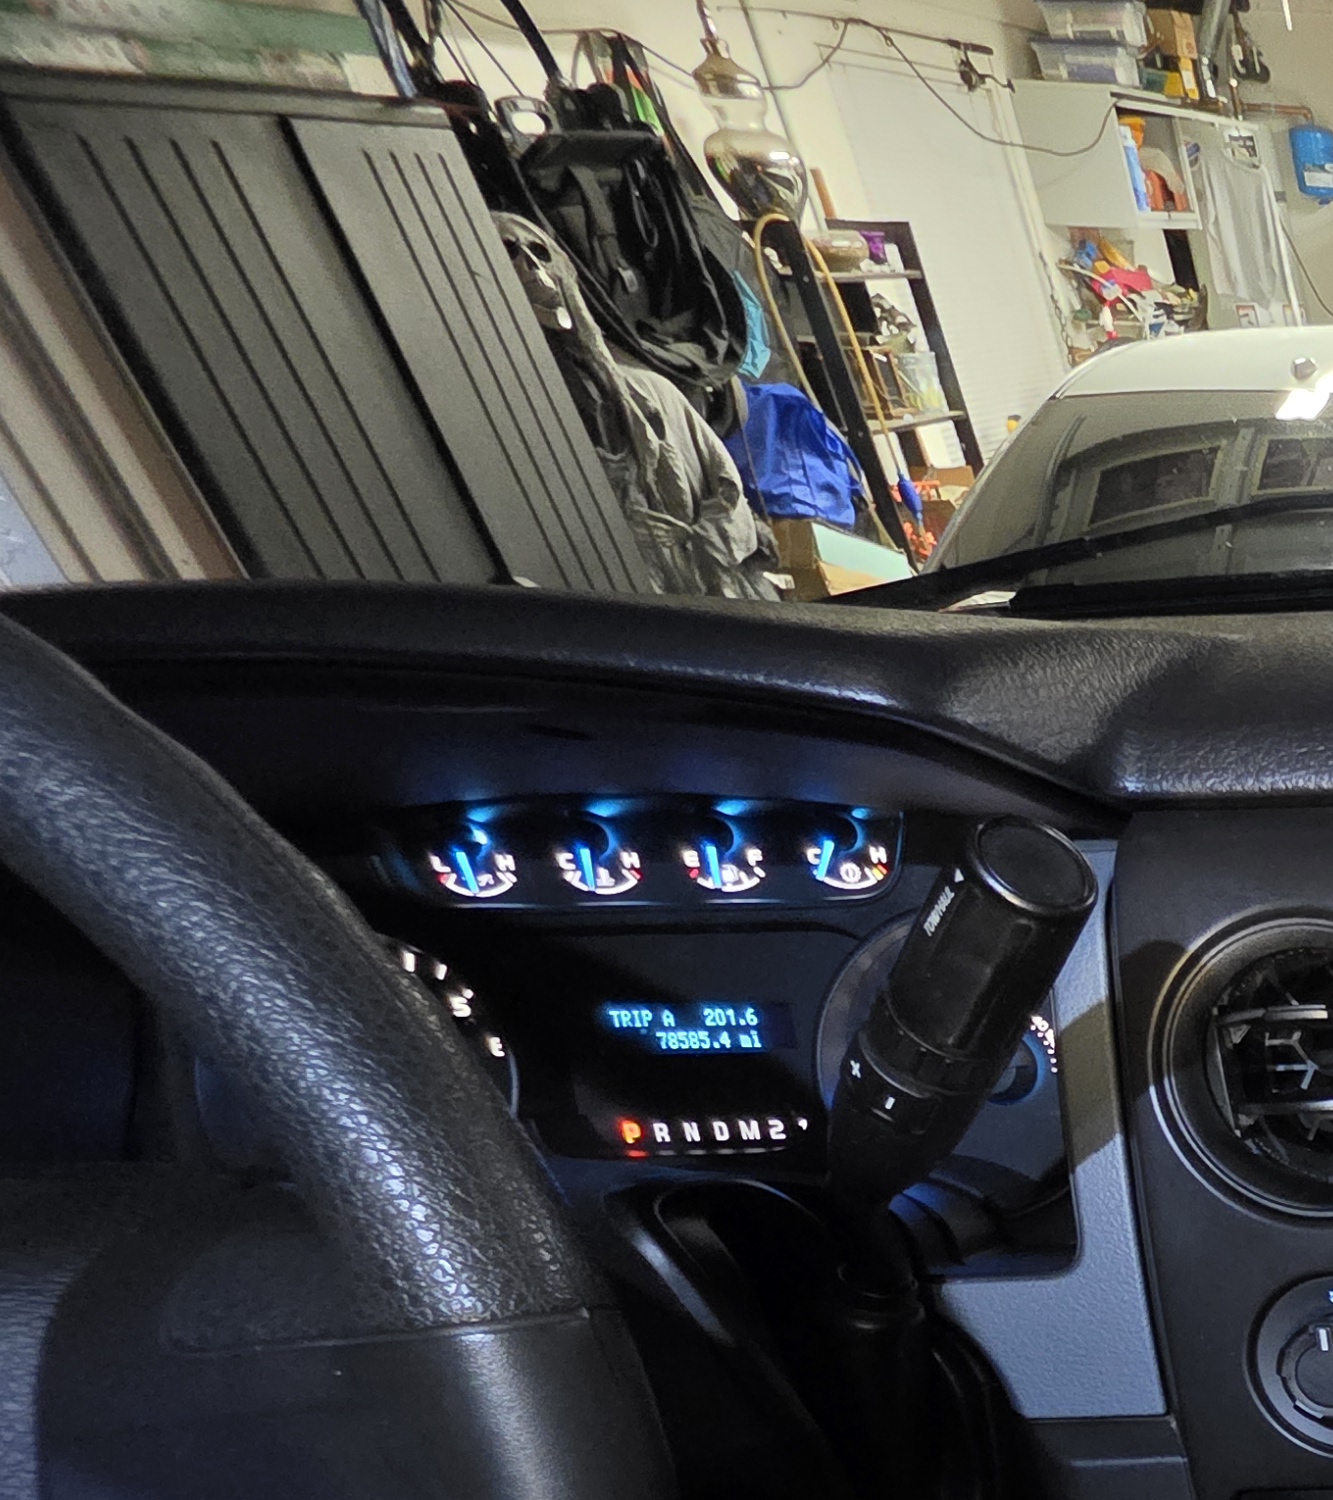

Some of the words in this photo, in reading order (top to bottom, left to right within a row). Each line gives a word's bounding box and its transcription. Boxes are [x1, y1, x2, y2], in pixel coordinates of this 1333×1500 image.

[619, 851, 641, 869] H
[682, 849, 700, 868] E
[748, 848, 764, 867] F
[870, 846, 888, 864] H
[608, 1008, 652, 1028] TRIP
[661, 1009, 676, 1028] A
[703, 1007, 758, 1027] 201.6
[656, 1030, 731, 1050] 78585.4
[739, 1029, 763, 1048] mi
[621, 1119, 642, 1145] P
[652, 1121, 671, 1143] R
[682, 1121, 701, 1142] N
[711, 1120, 730, 1142] D
[738, 1119, 761, 1140] M
[767, 1119, 787, 1140] 2
